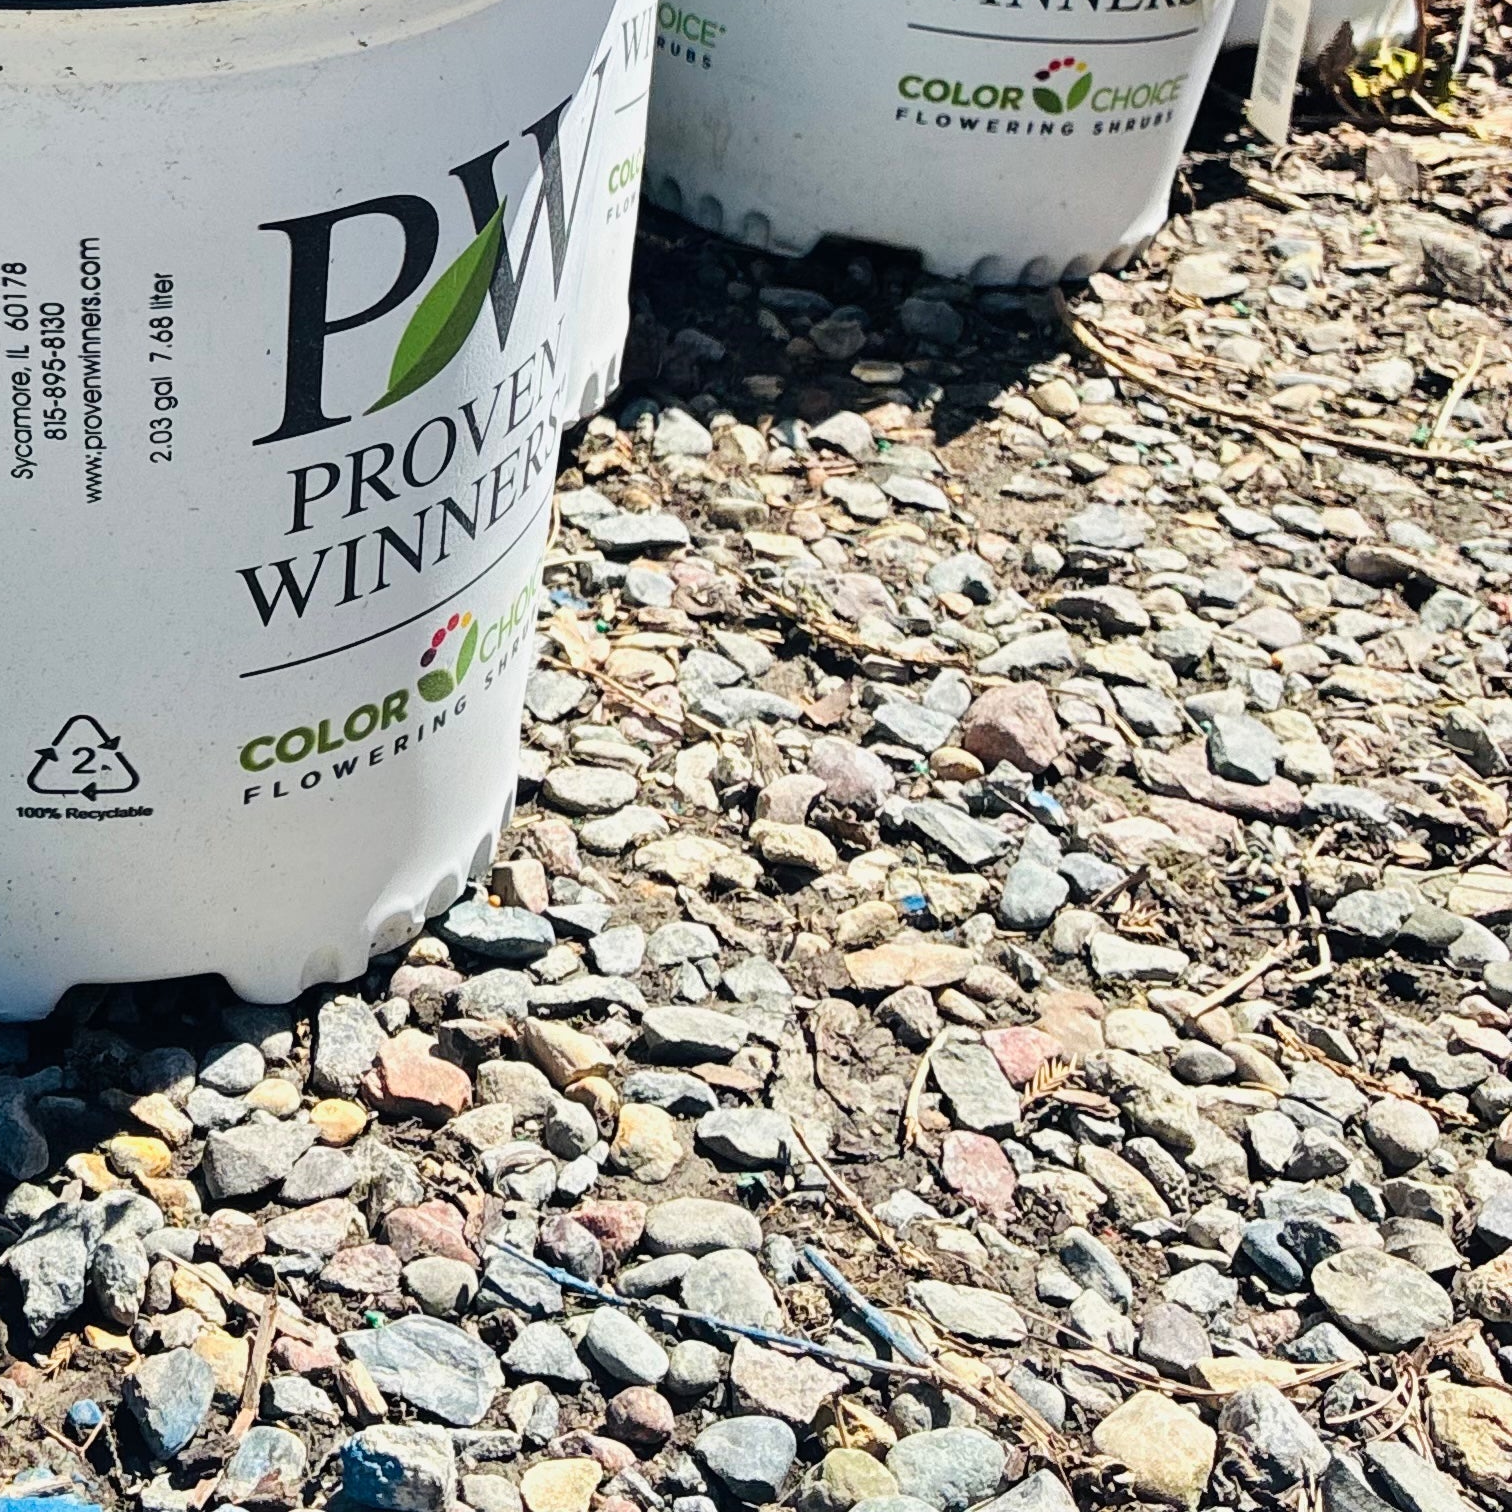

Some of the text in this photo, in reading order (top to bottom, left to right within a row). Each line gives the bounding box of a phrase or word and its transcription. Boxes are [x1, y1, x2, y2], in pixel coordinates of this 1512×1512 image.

[657, 1, 718, 49] OICE
[895, 106, 1075, 137] FLOWERING
[898, 74, 1187, 113] COLOR CHOICE
[252, 46, 612, 446] PW
[1, 262, 38, 479] Sycamore, IL 60178
[39, 302, 67, 441] 815-895-8130
[149, 273, 178, 463] 2.03 gal 7.68 liter
[284, 313, 566, 536] PROVEN
[239, 556, 543, 772] COLOR CHOIC
[72, 746, 97, 774] 2
[243, 694, 467, 805] FLOWERING
[16, 806, 154, 822] 100% Recyclable
